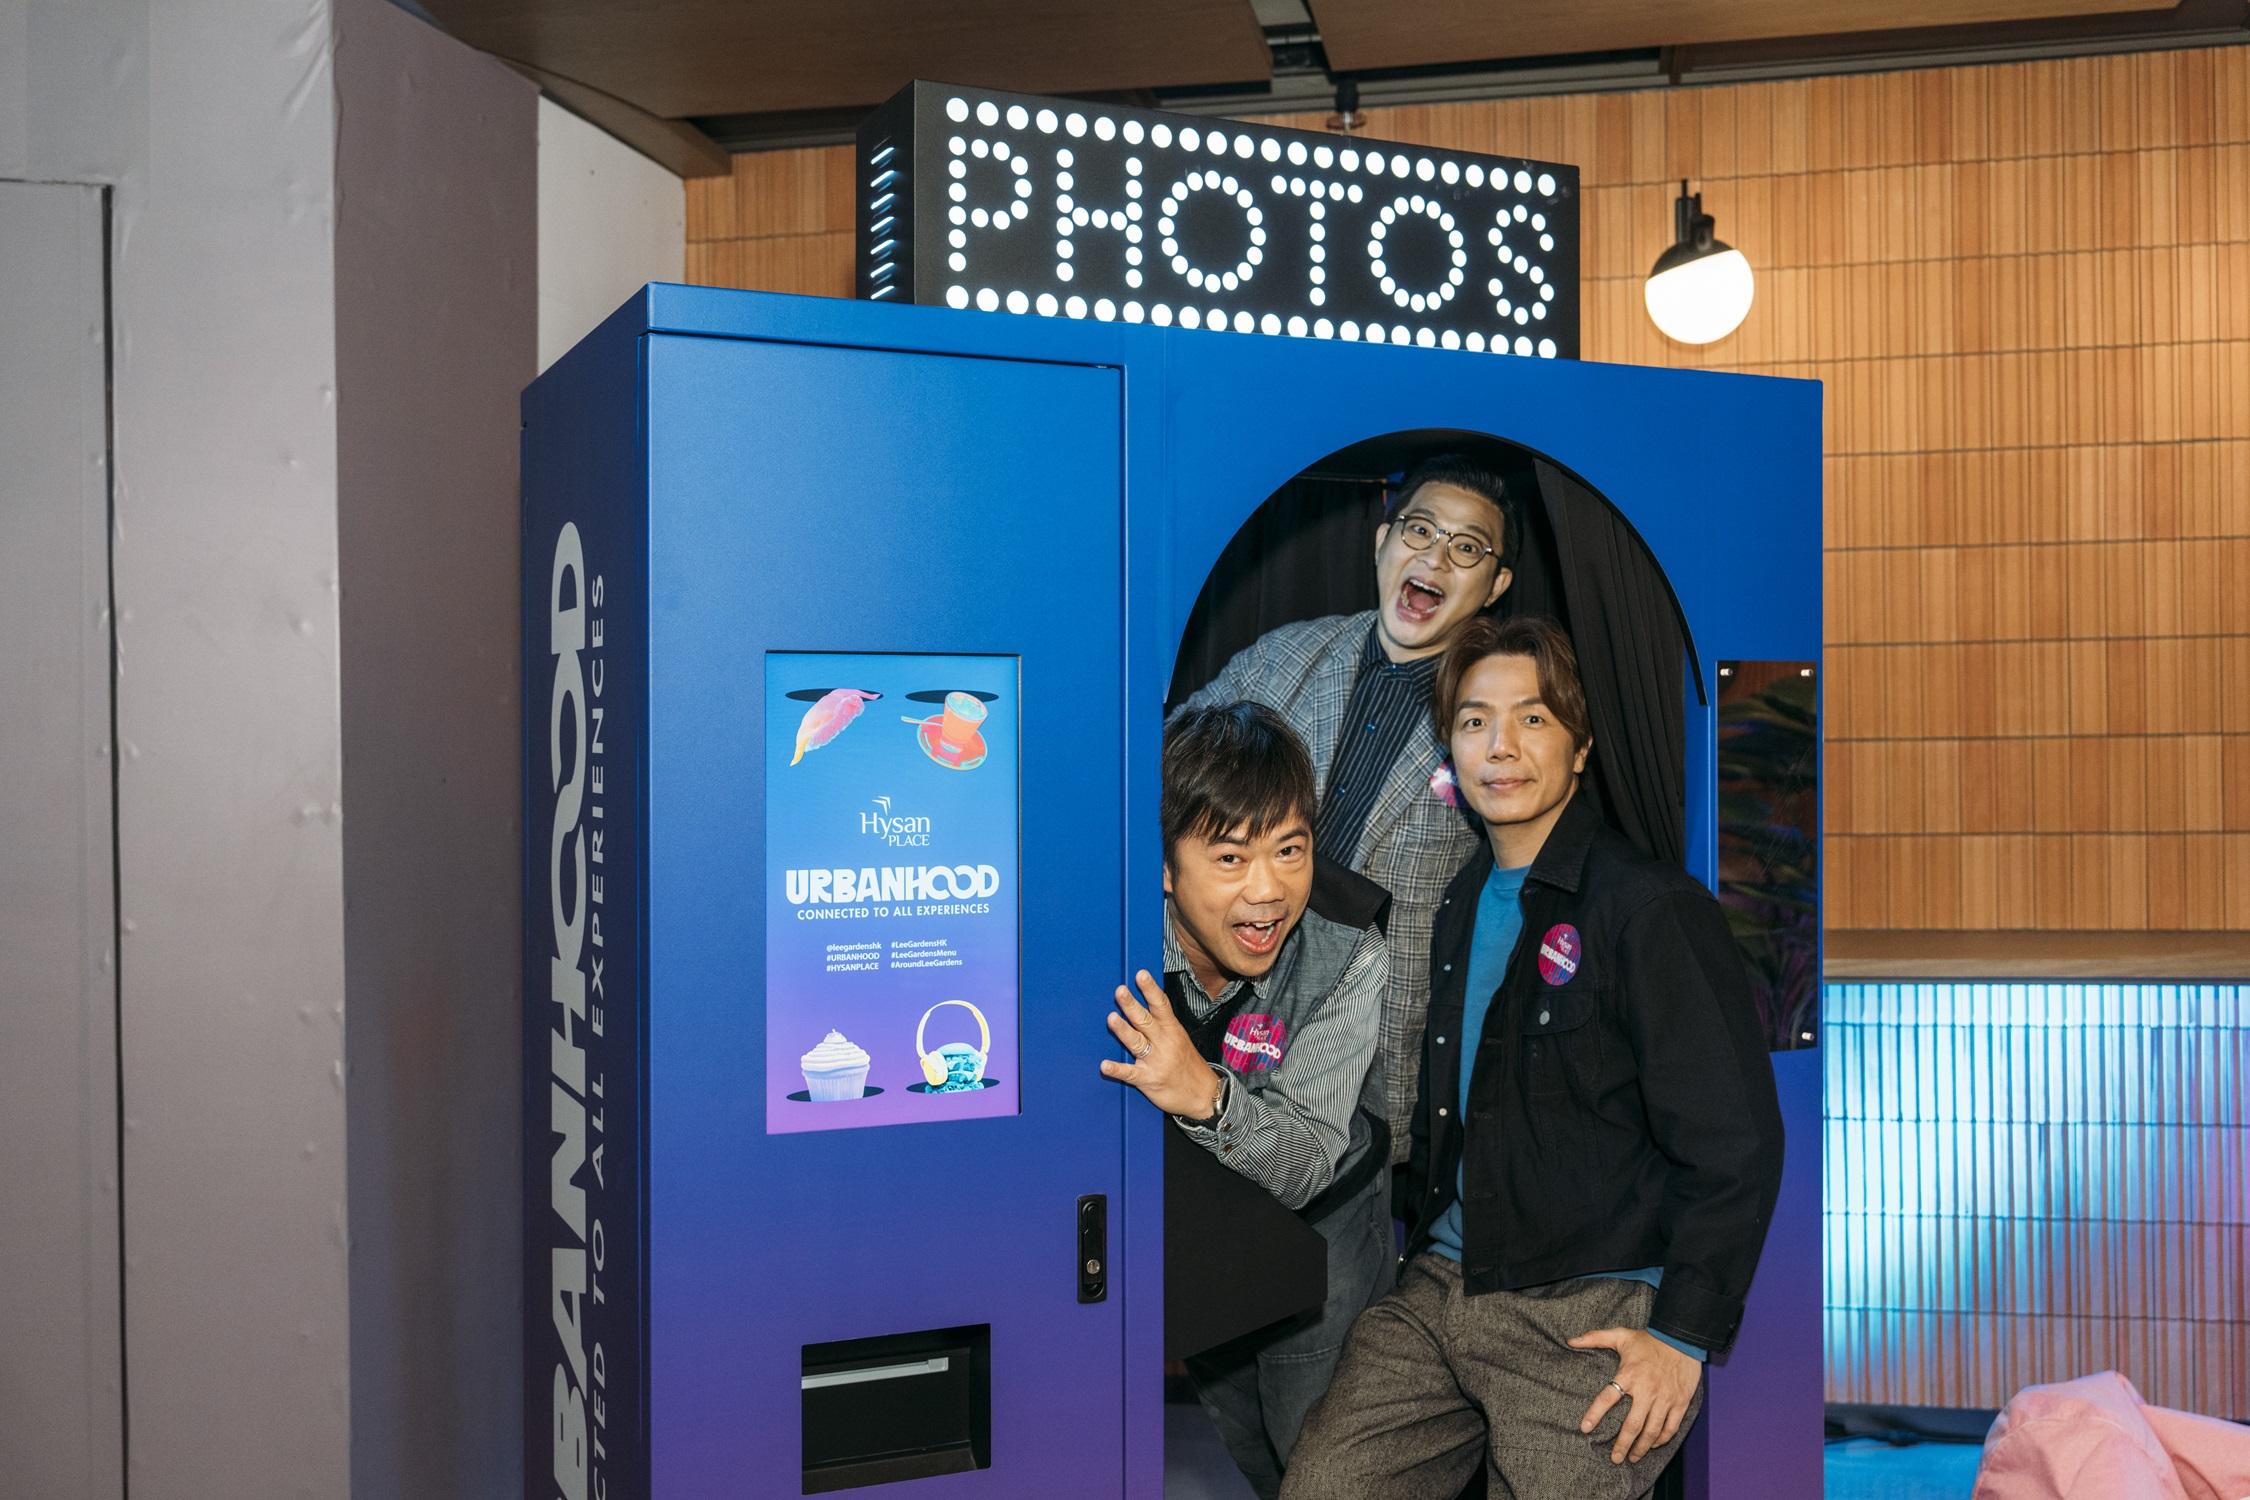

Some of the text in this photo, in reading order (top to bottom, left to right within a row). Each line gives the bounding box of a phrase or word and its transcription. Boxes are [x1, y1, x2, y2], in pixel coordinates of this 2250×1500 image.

[947, 135, 1555, 325] PHOTOS
[591, 574, 604, 1037] EXPERIENCES
[859, 811, 931, 840] Hysan
[888, 833, 930, 847] PLACE
[785, 864, 1000, 905] URBANHOOD
[797, 903, 990, 921] CONNECTED TO ALL EXPERIENCES
[826, 942, 882, 952] @leegardenshk
[891, 939, 947, 949] #LeeGardensHK
[826, 952, 880, 962] #URBANHOOD
[891, 949, 957, 959] #LeeGardensMenu
[826, 962, 880, 972] #HYSANPLACE
[891, 959, 962, 969] #AroundLeeGardens
[551, 521, 588, 1500] BANHOOD
[592, 1073, 605, 1190] ALL
[592, 1219, 605, 1305] TO
